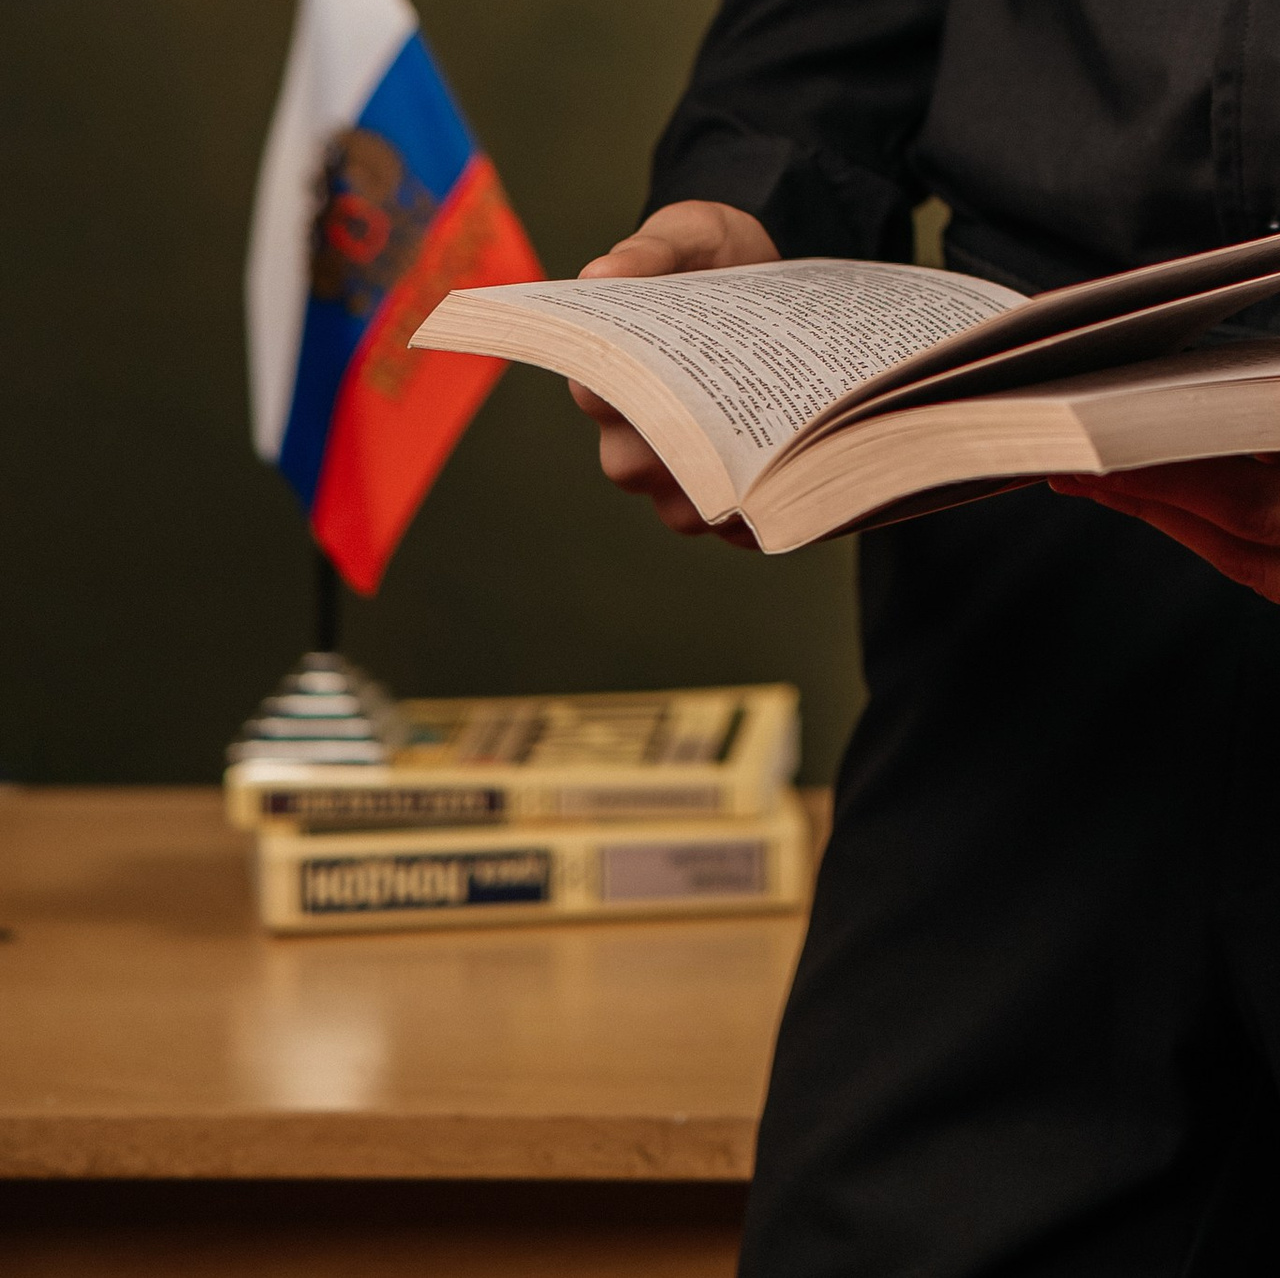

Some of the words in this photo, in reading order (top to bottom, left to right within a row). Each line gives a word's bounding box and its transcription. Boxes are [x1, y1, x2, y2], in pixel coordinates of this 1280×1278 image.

[859, 338, 891, 368] очестер,
[719, 366, 750, 394] Джейн
[841, 356, 867, 381] отому
[742, 375, 767, 402] скоро
[755, 376, 783, 408] четыре
[748, 395, 764, 413] Это
[782, 409, 799, 431] ерез
